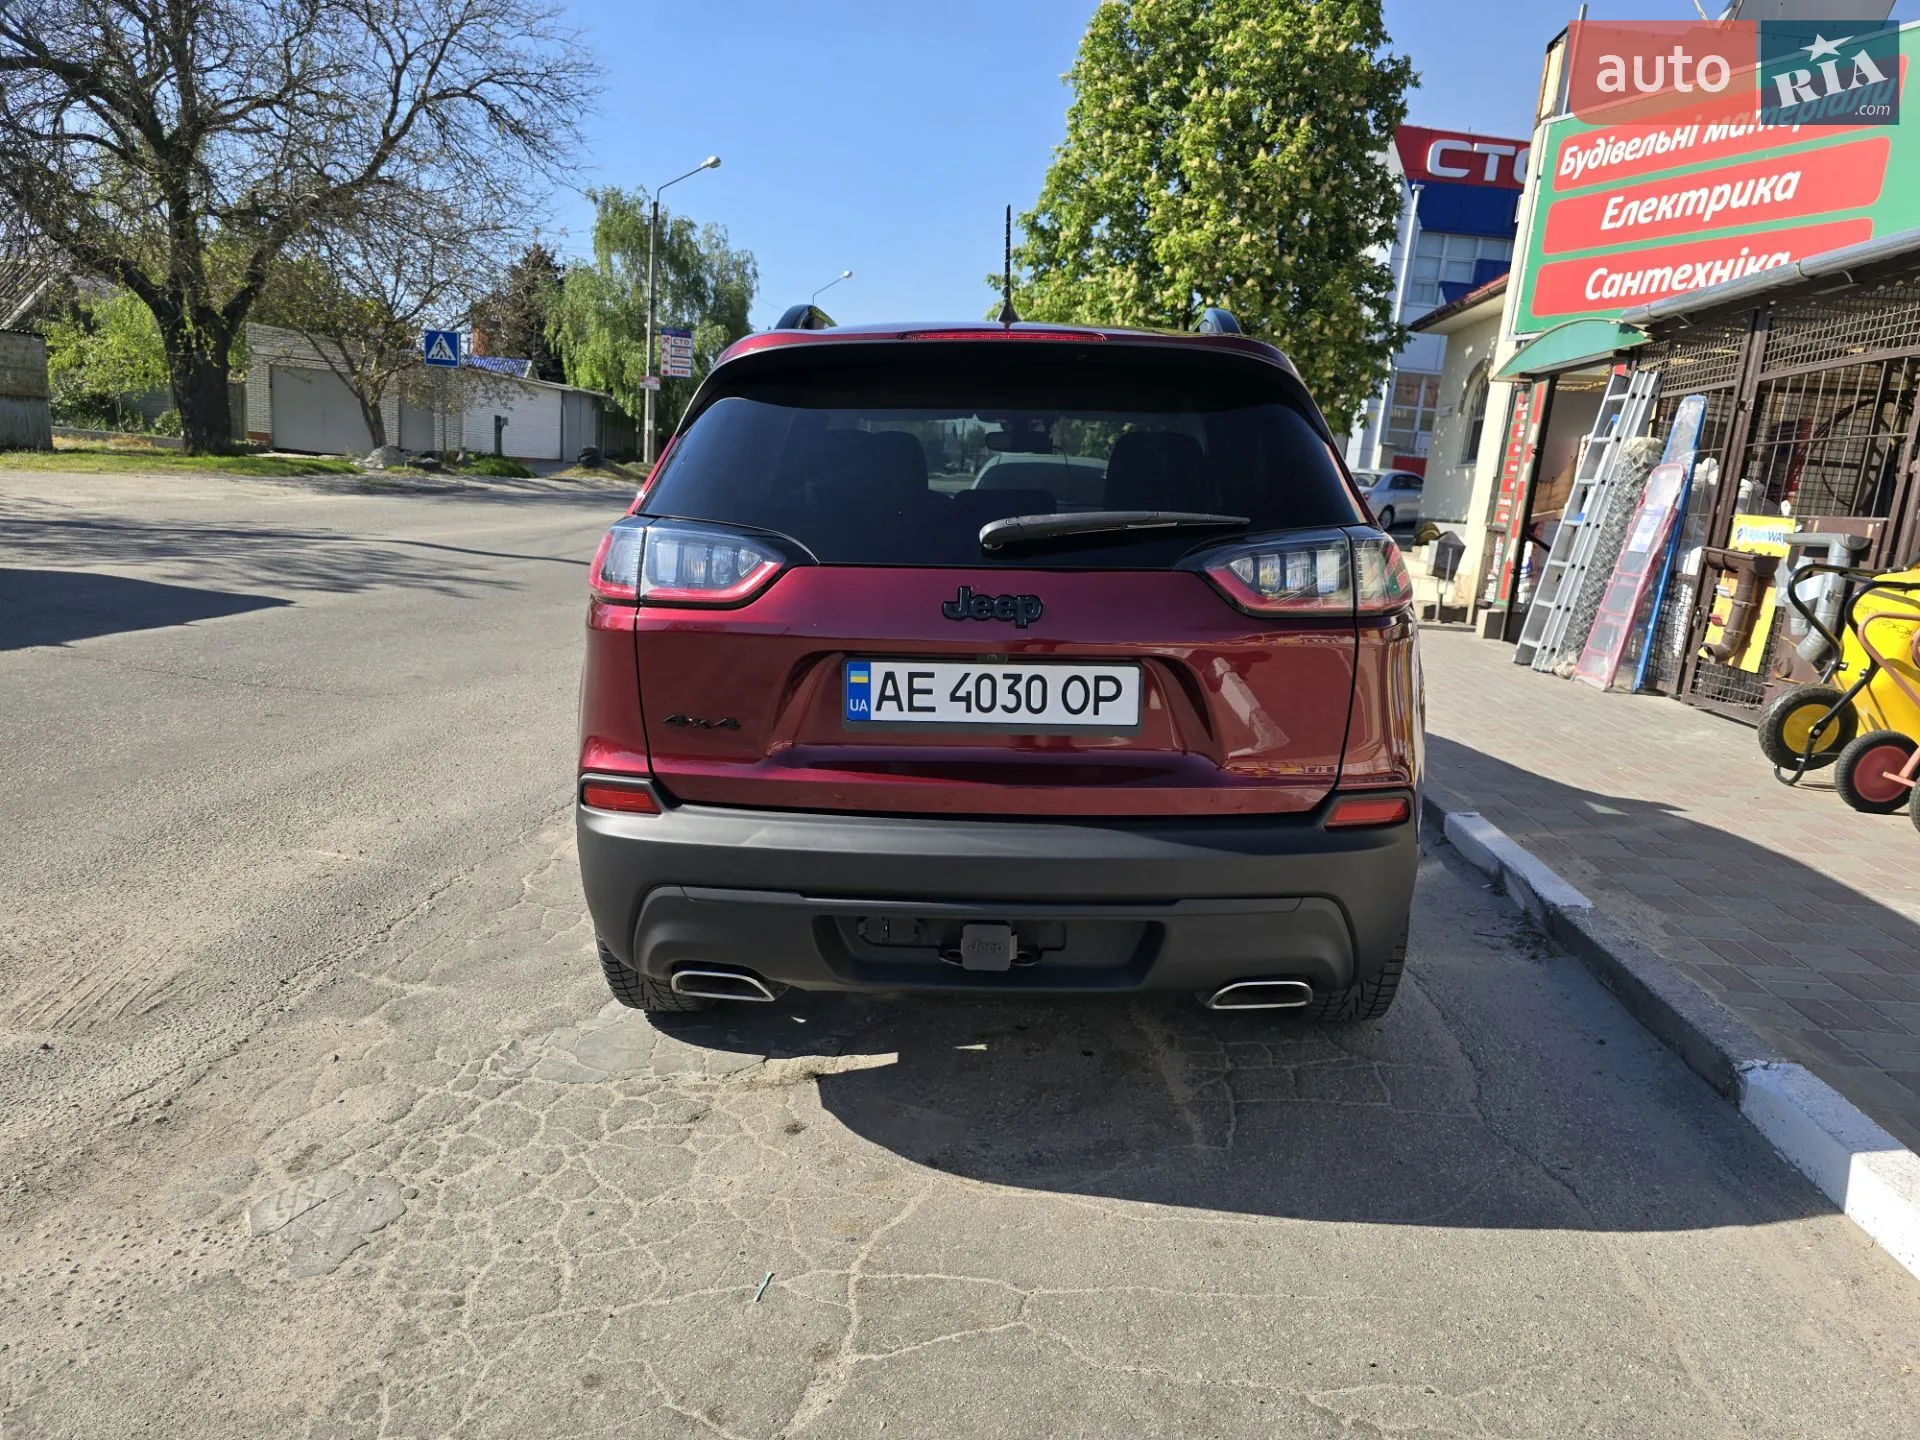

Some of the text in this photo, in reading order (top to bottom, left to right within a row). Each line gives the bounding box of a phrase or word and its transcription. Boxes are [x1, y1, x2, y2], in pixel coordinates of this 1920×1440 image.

[1559, 115, 1698, 181] Будівельні
[1600, 171, 1801, 231] Електрика
[673, 338, 690, 346] СТО
[942, 586, 1043, 629] Jeep
[850, 699, 869, 712] UA
[875, 671, 1123, 716] AE 4030 OP
[969, 939, 1005, 955] Jeep
